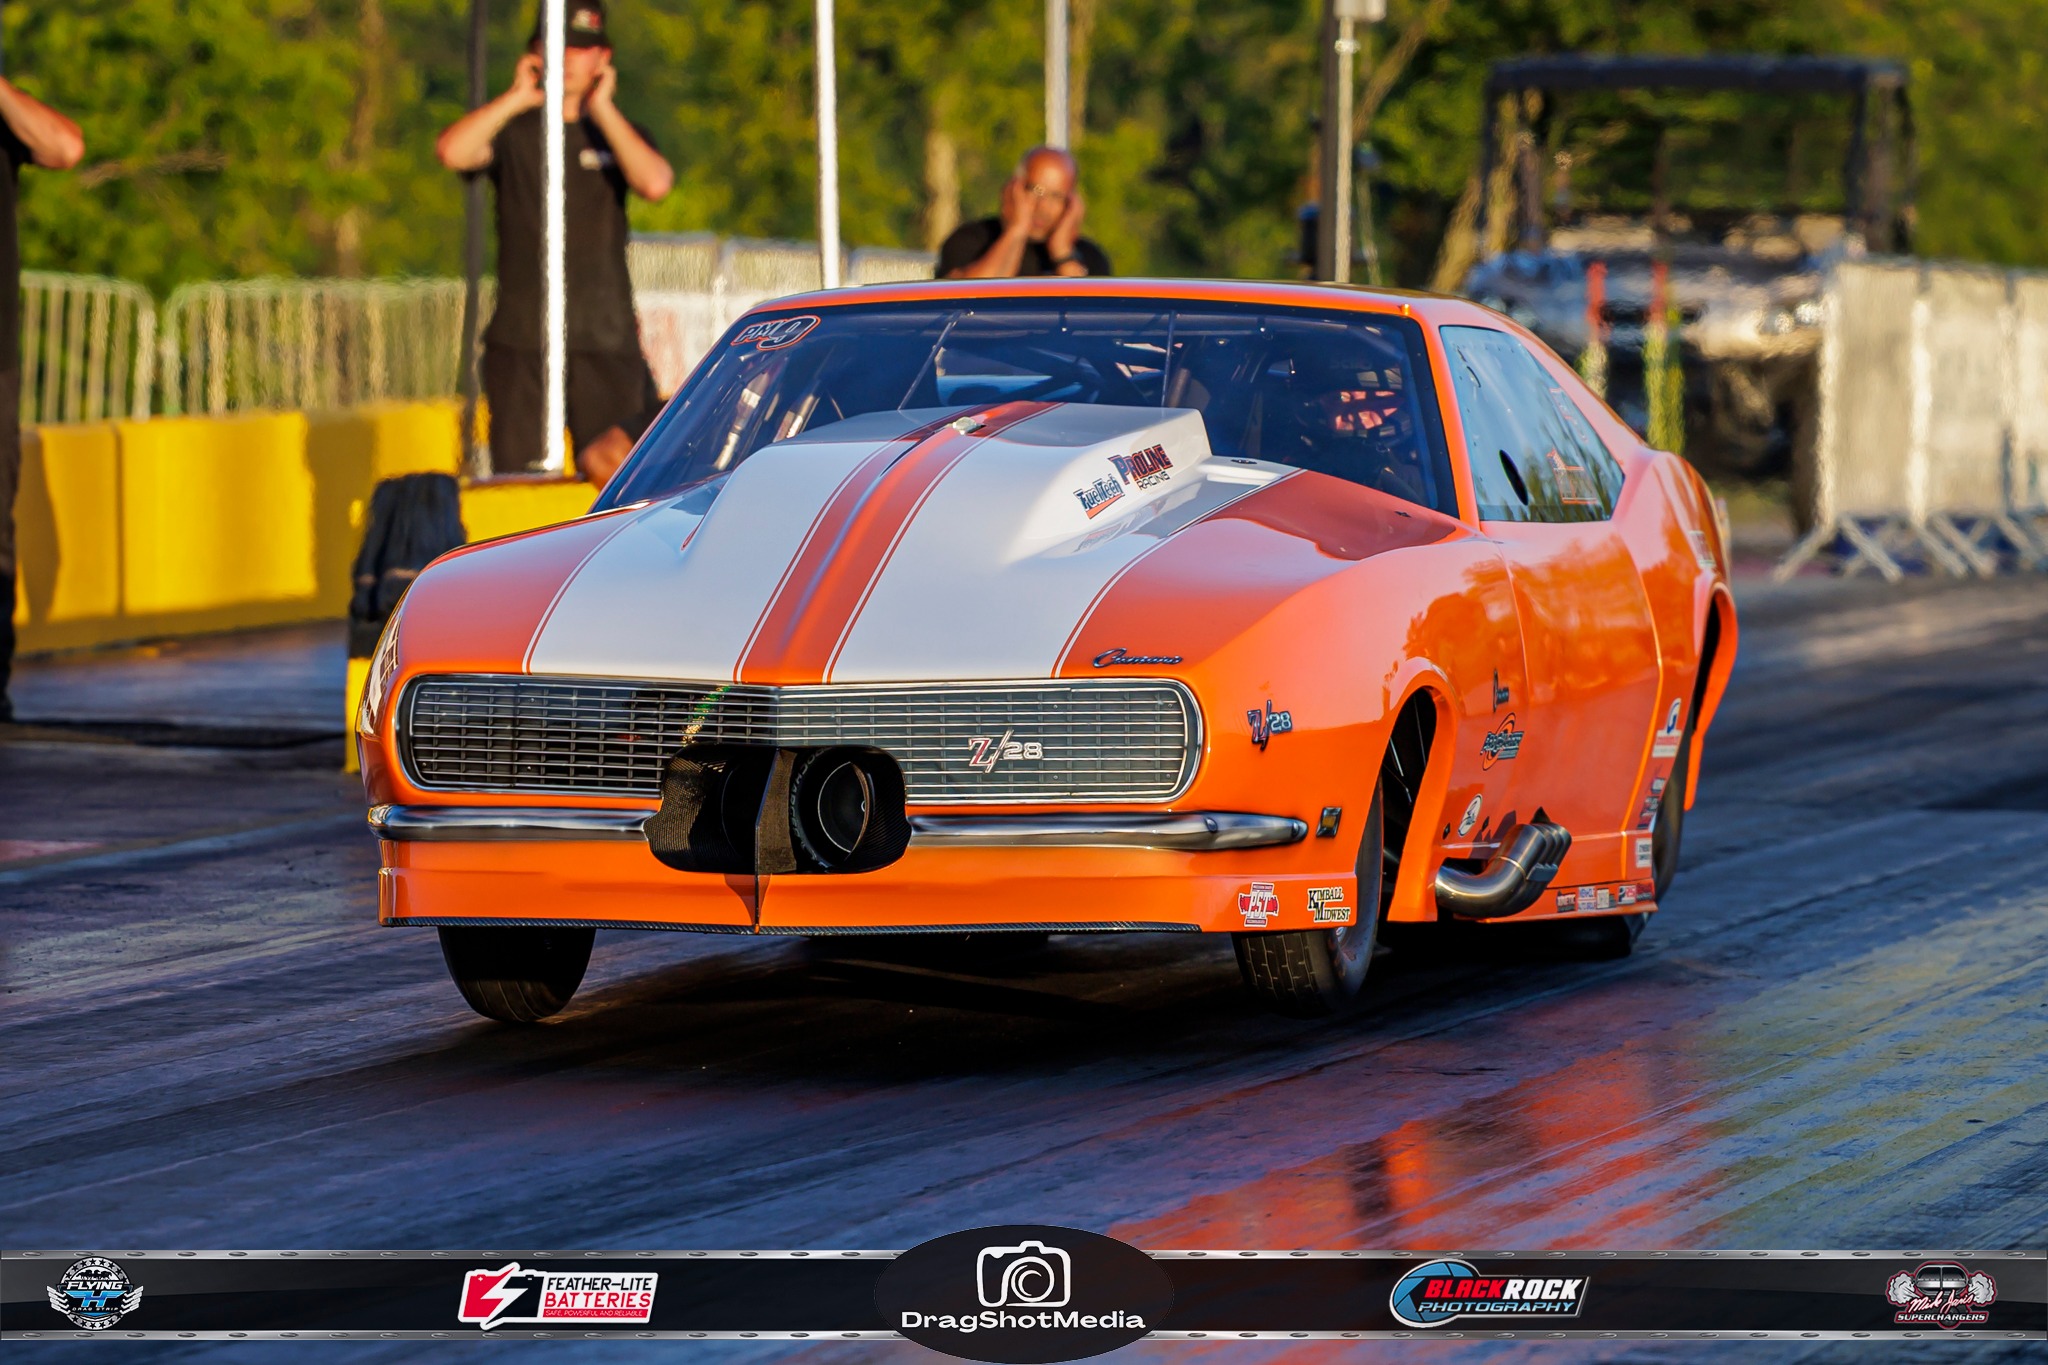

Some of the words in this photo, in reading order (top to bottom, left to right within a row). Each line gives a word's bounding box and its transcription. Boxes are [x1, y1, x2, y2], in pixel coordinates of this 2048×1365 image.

[1107, 444, 1173, 485] PROLINE
[1073, 473, 1126, 512] FuelTech
[1136, 470, 1171, 491] RACING
[968, 728, 1044, 773] Z/28
[1246, 890, 1273, 919] PST
[1308, 887, 1344, 909] KIMBALL
[1315, 901, 1350, 922] MIDWEST
